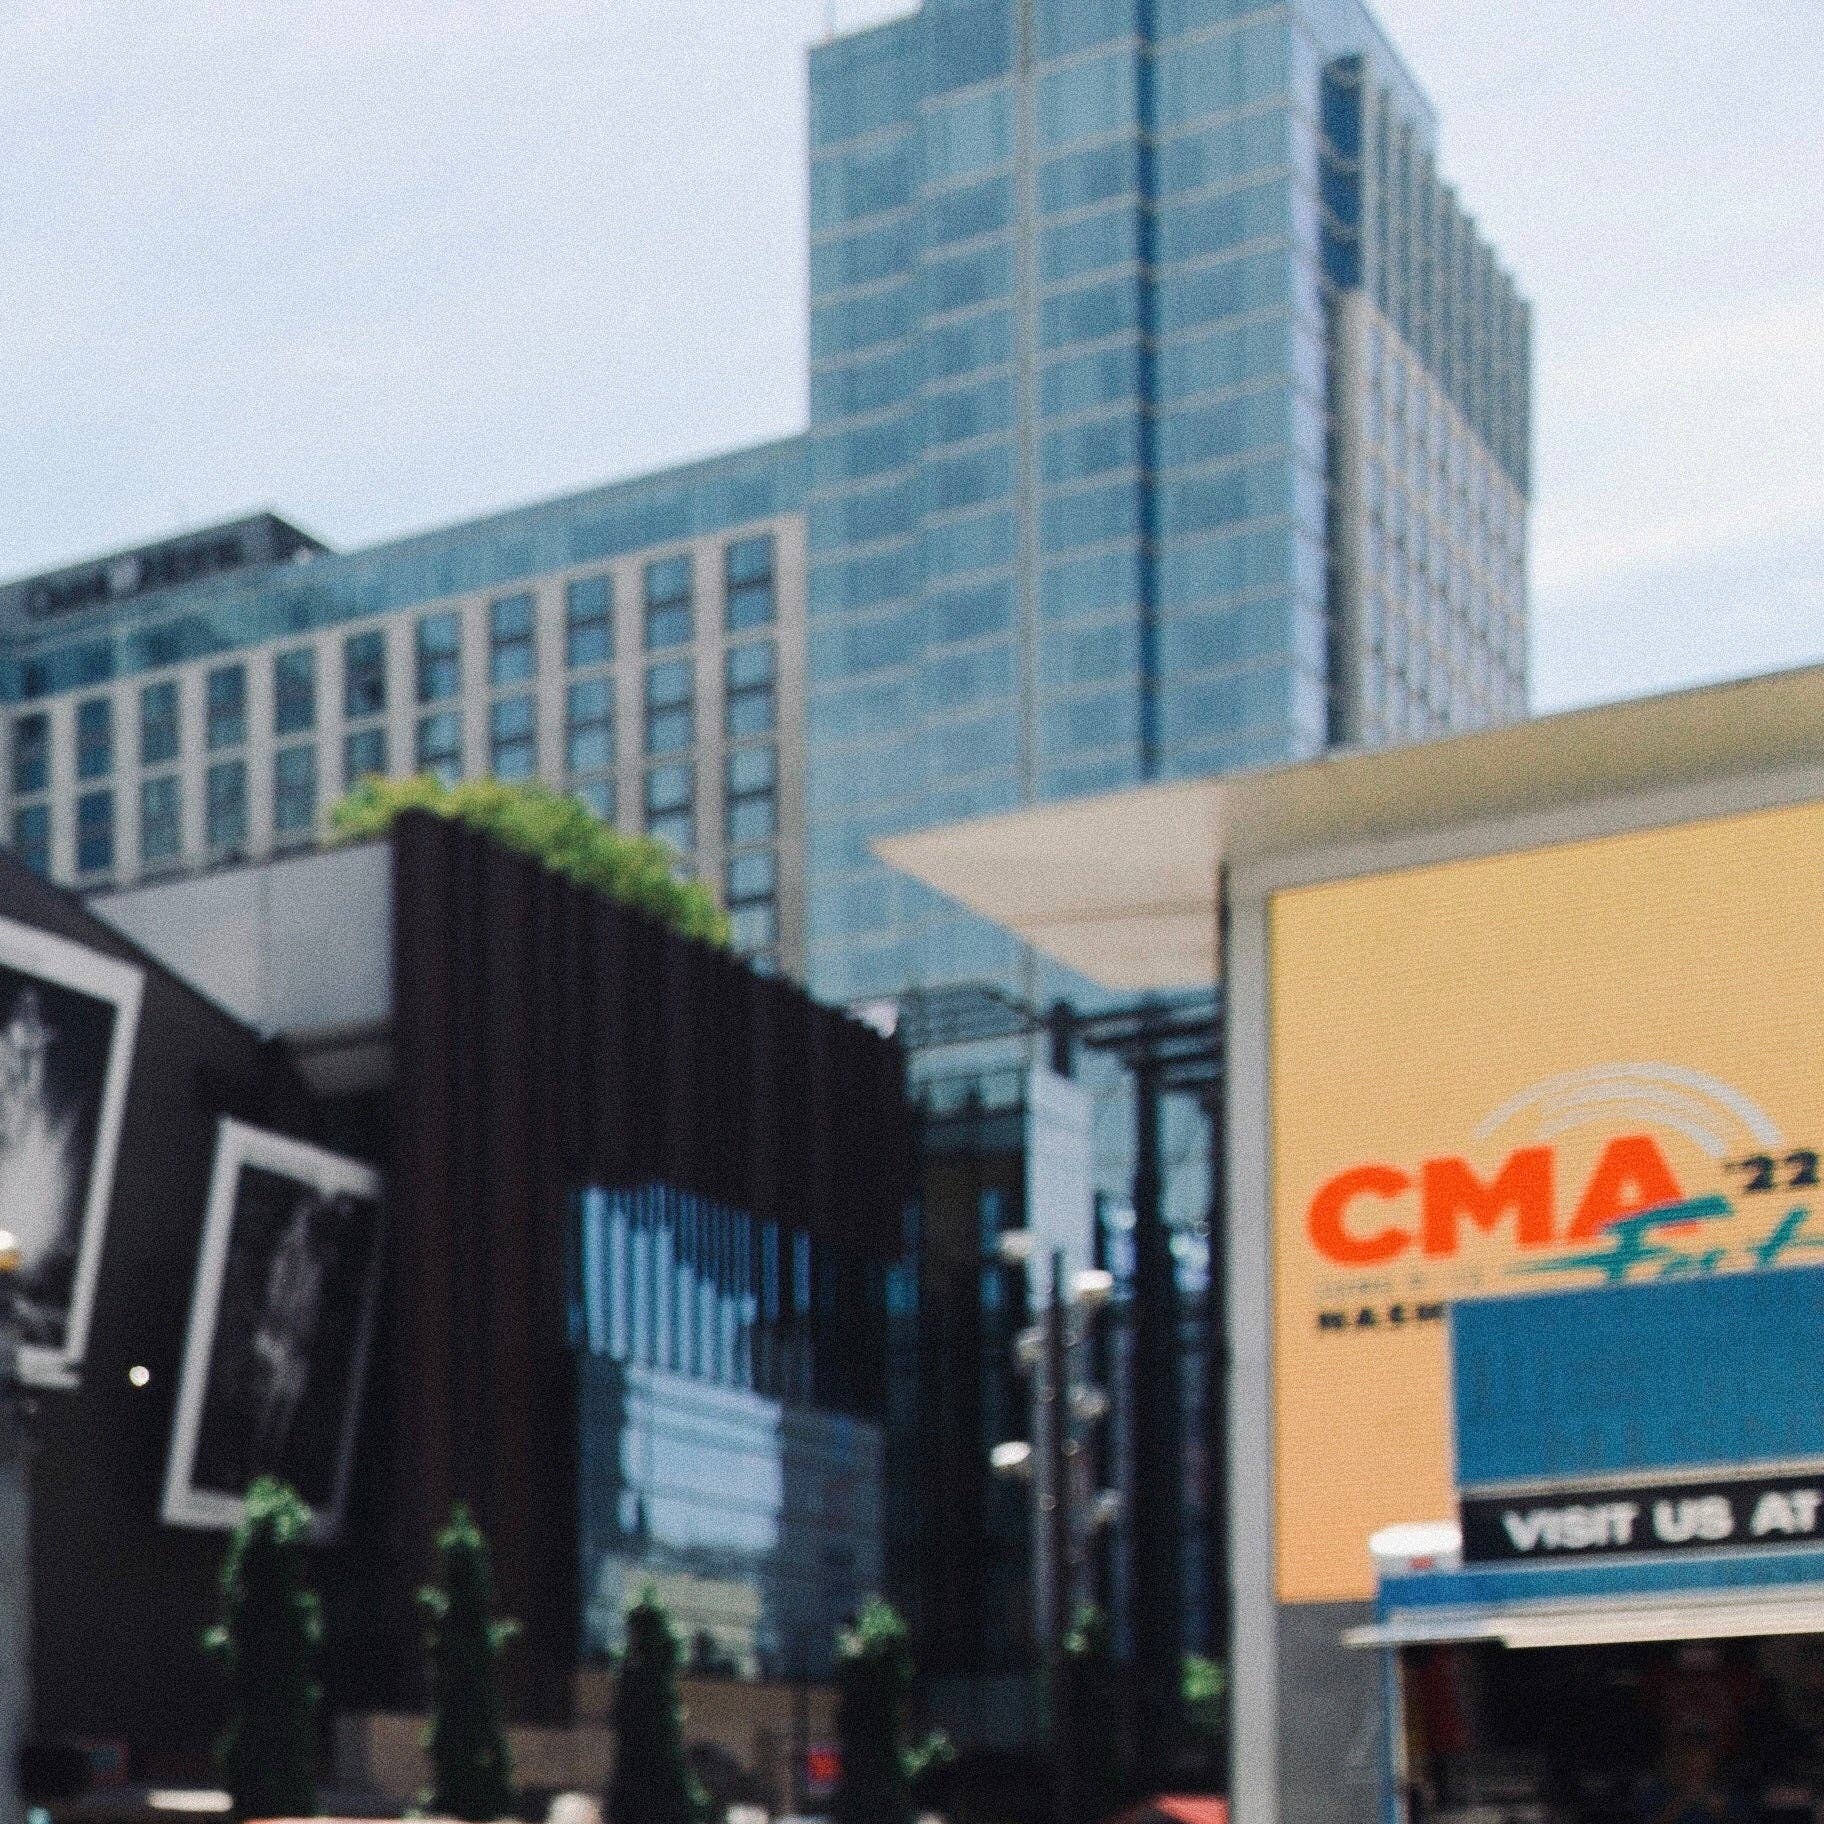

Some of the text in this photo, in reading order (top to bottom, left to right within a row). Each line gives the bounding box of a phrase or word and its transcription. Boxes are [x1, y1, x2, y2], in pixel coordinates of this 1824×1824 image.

[1305, 1133, 1702, 1268] CMA
[1502, 1489, 1822, 1551] VISIT US AT
